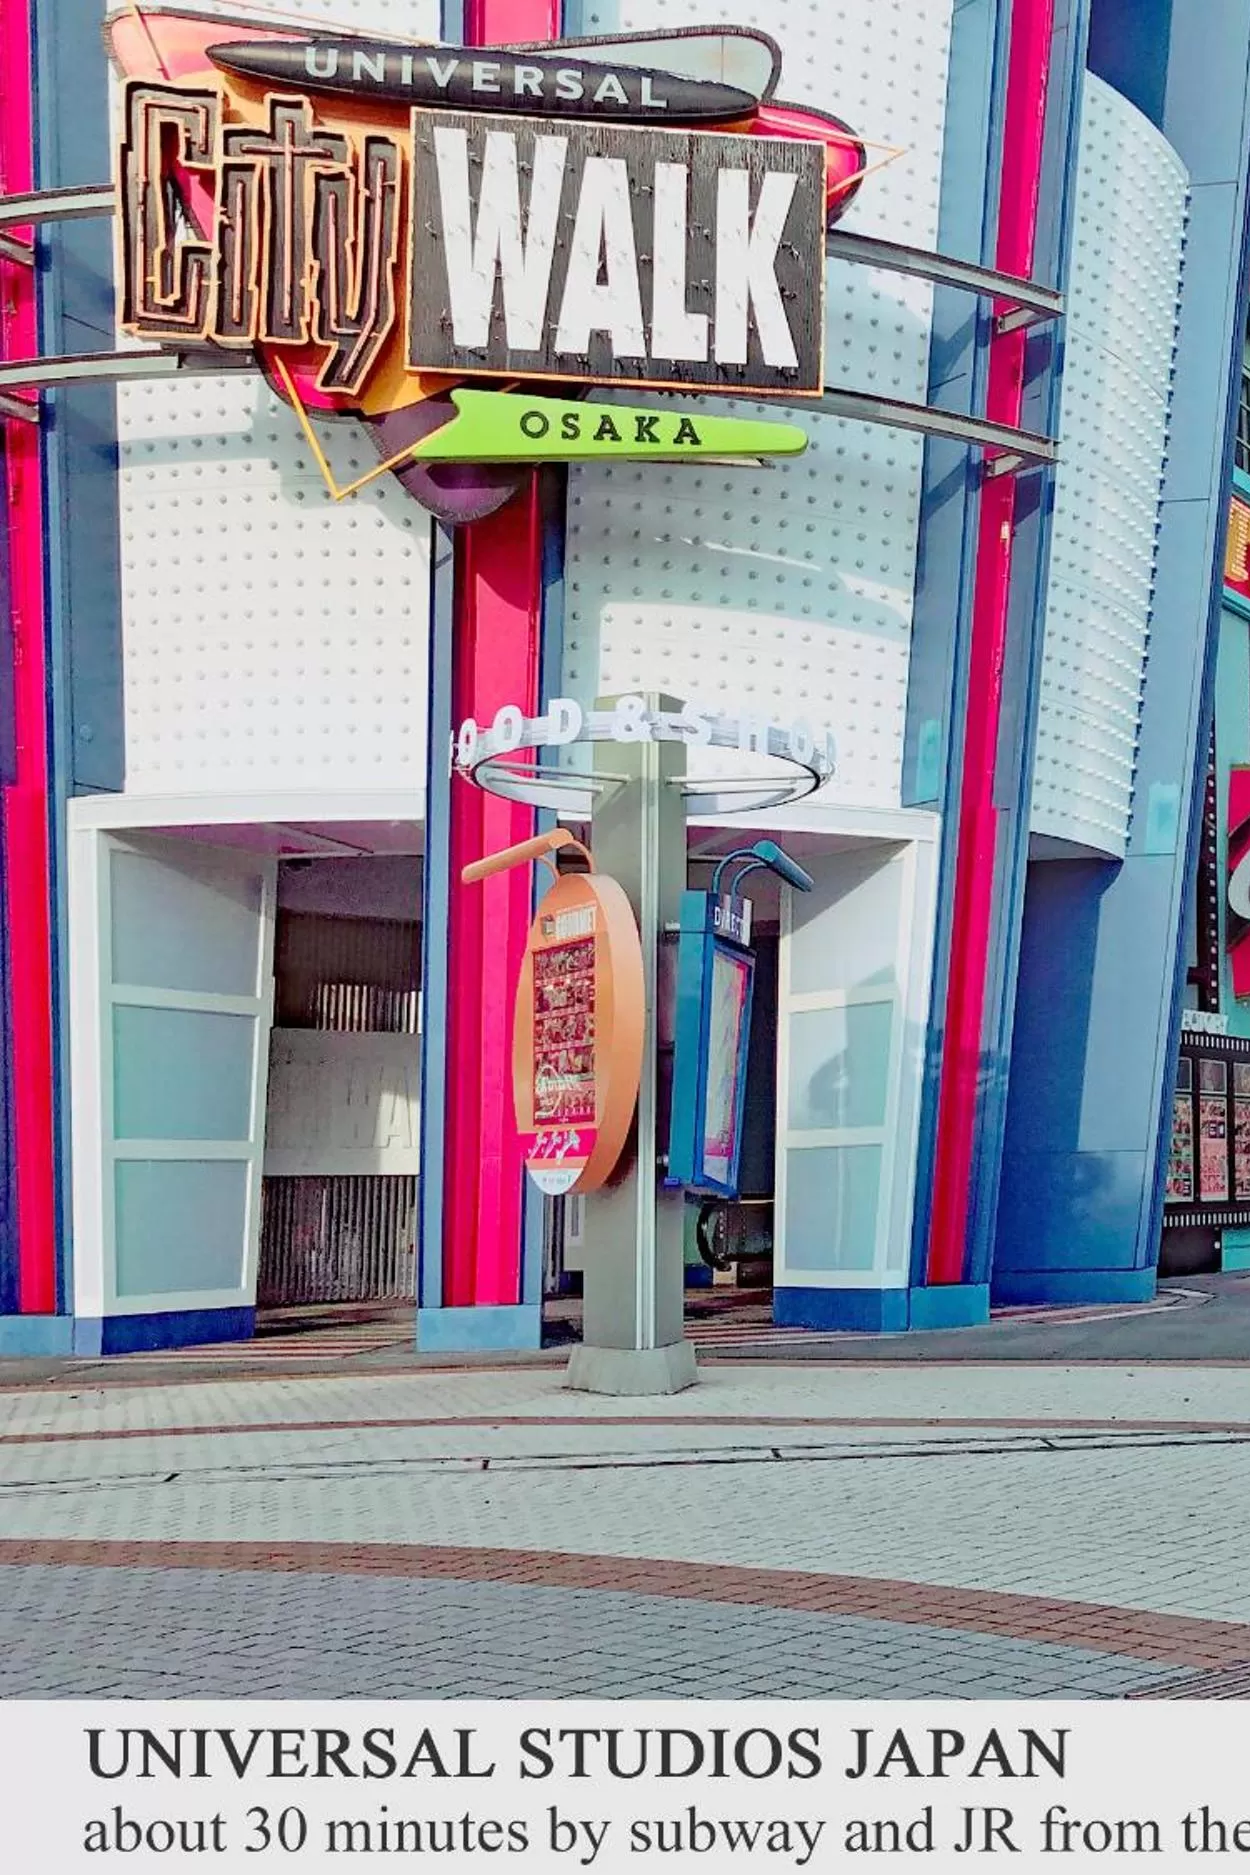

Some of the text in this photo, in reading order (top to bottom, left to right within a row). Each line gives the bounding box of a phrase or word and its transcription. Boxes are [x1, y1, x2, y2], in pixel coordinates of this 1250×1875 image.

[303, 45, 669, 108] UNIVERSAL
[431, 126, 800, 368] WALK
[519, 410, 703, 446] OSAKA
[449, 697, 584, 777] OOD
